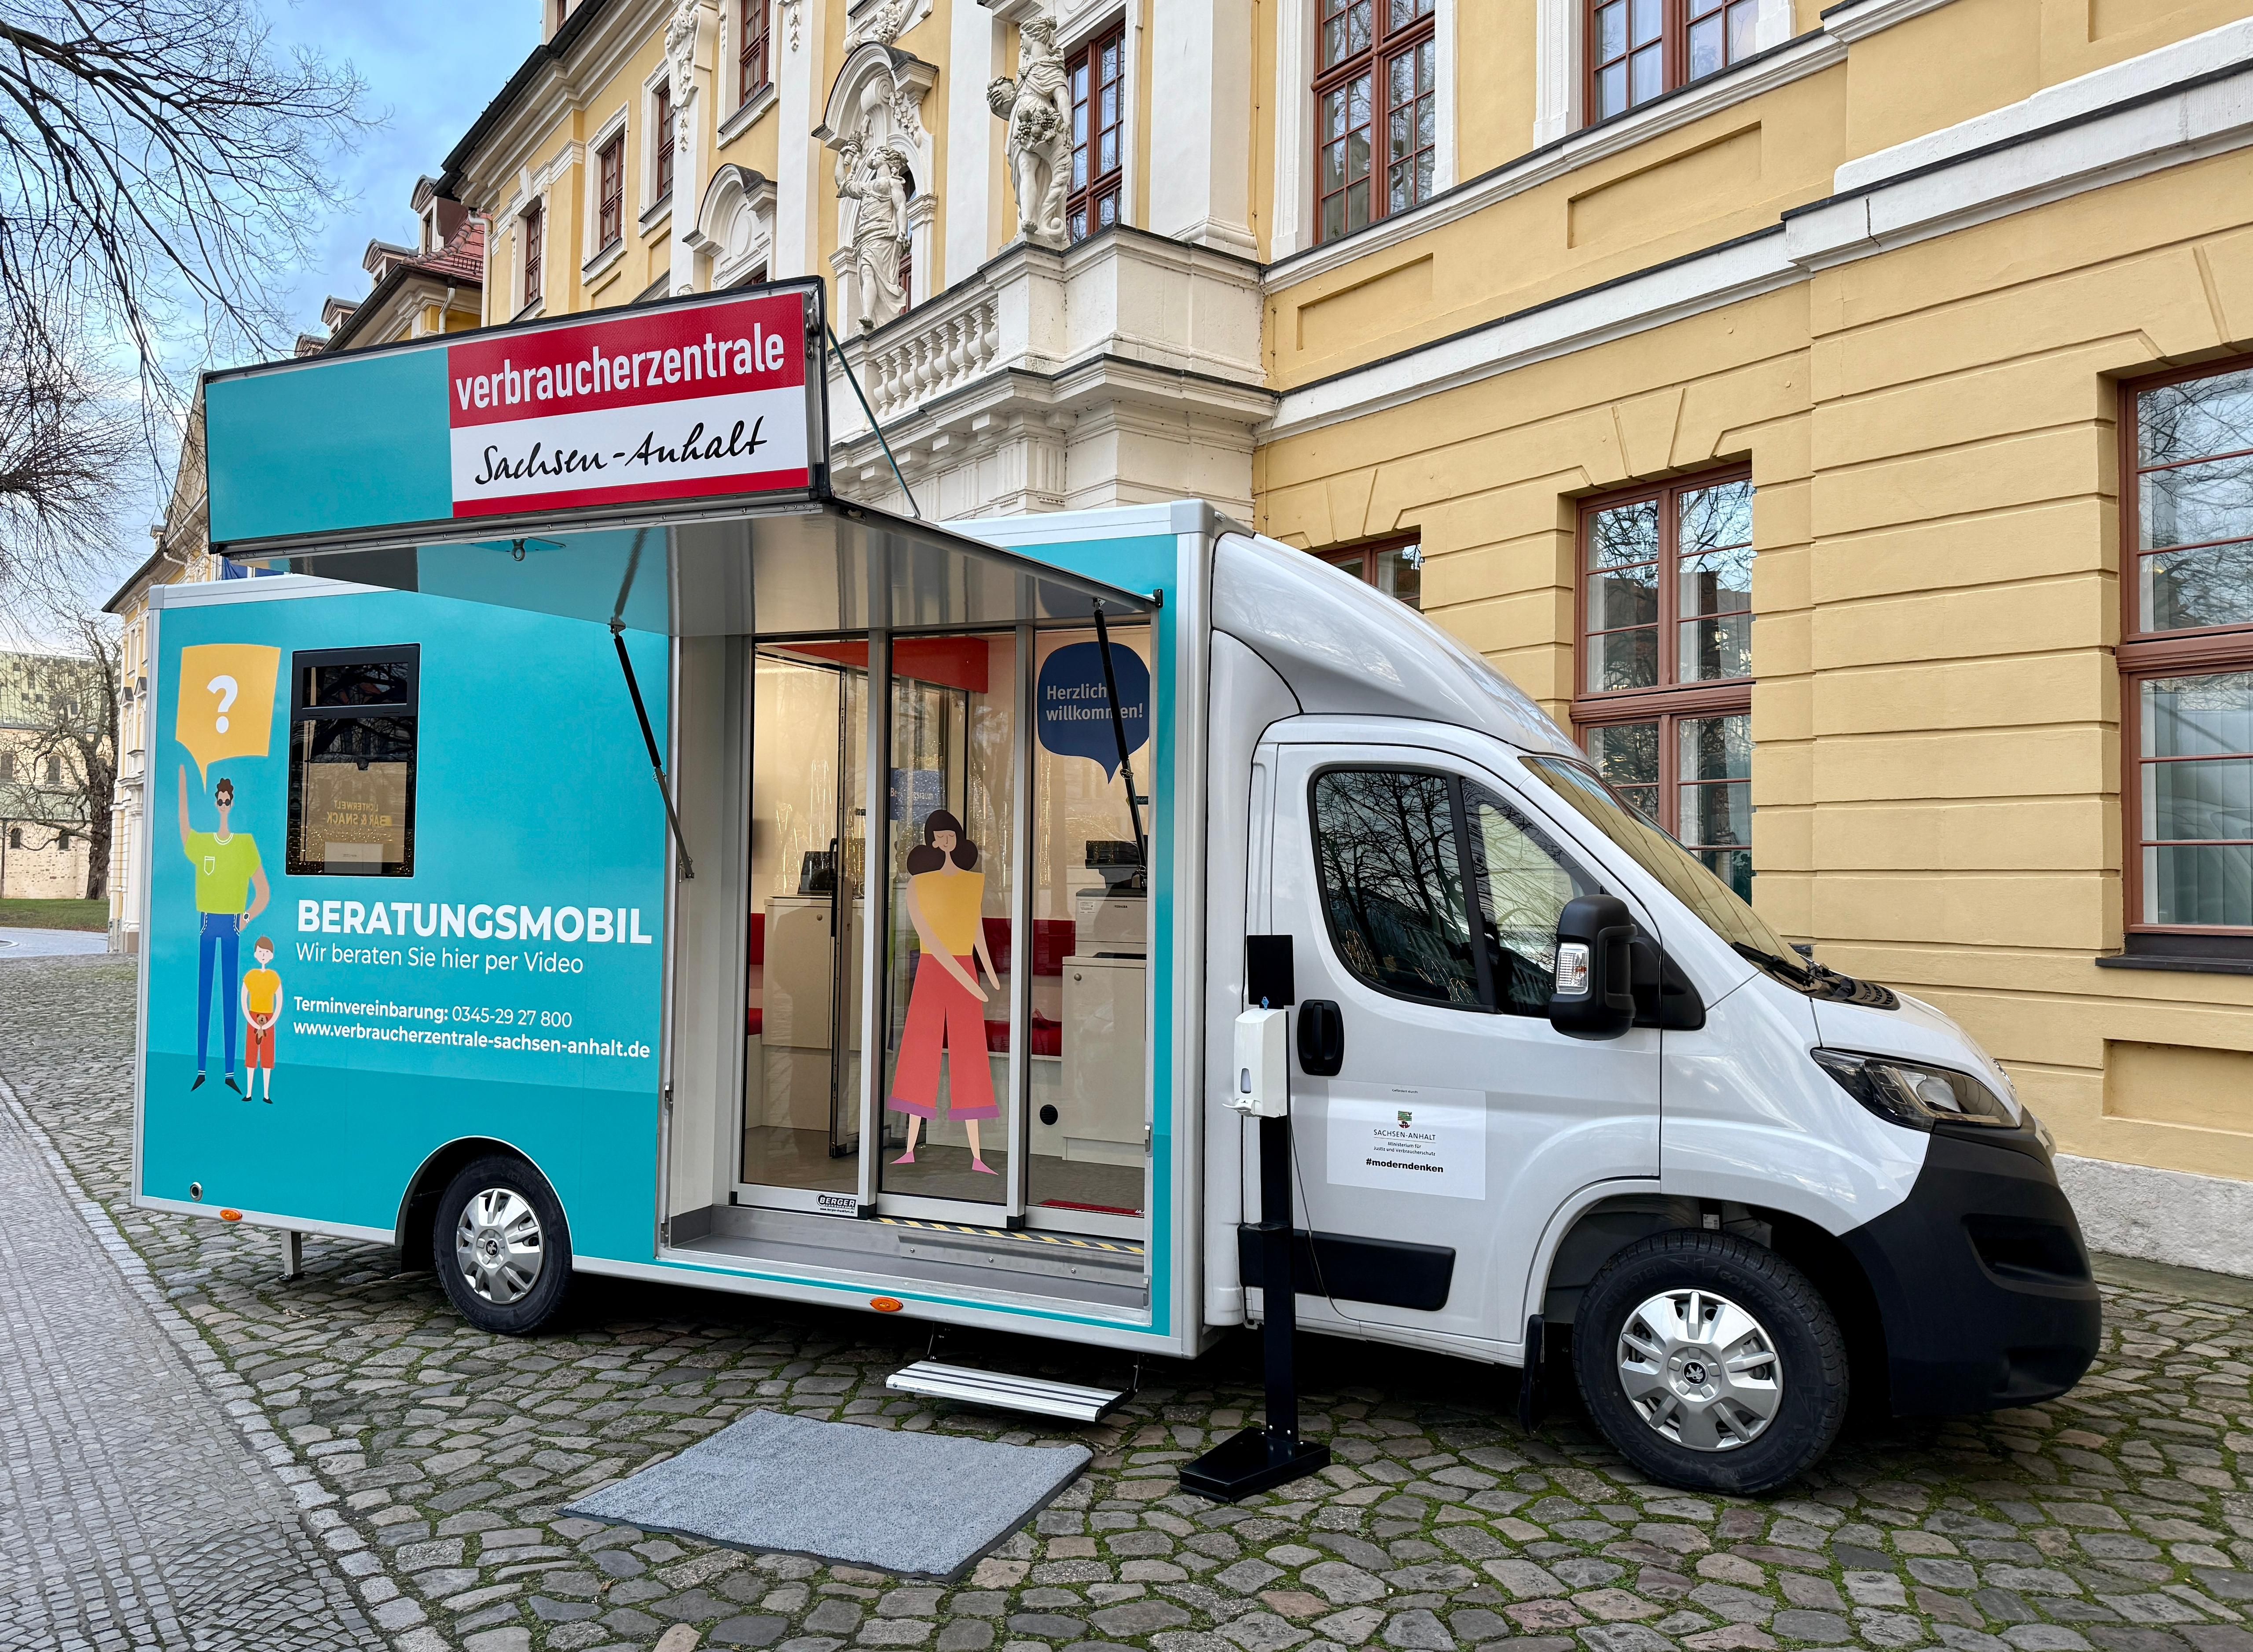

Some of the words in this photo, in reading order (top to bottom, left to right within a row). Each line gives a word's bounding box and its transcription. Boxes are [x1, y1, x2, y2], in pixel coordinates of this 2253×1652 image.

[455, 323, 784, 410] verbraucherzentrale
[475, 416, 767, 485] Sachsen-Anhalt
[207, 675, 238, 733] ?
[1047, 683, 1107, 700] Herzlich
[890, 787, 933, 800] Begsraum
[298, 900, 652, 945] BERATUNGSMOBIL
[296, 942, 327, 962] Wir
[332, 946, 402, 966] beraten
[408, 947, 436, 967] Sie
[442, 948, 479, 969] hier
[485, 955, 518, 974] per
[524, 951, 583, 973] Video
[294, 996, 448, 1024] Terminvereinbarung:
[452, 1006, 514, 1024] 0345-29
[517, 1010, 536, 1025] 27
[540, 1011, 572, 1028] 800
[293, 1021, 650, 1058] www.verbraucherzentrale-sachsen-anhalt.de
[1373, 1129, 1436, 1140] SACHSEN-ANHALT
[1366, 1158, 1443, 1173] #moderndenken
[1395, 1148, 1436, 1156] Verbraucherschutz
[819, 1197, 855, 1207] BERGER
[1718, 1270, 1790, 1324] COMTRAC
